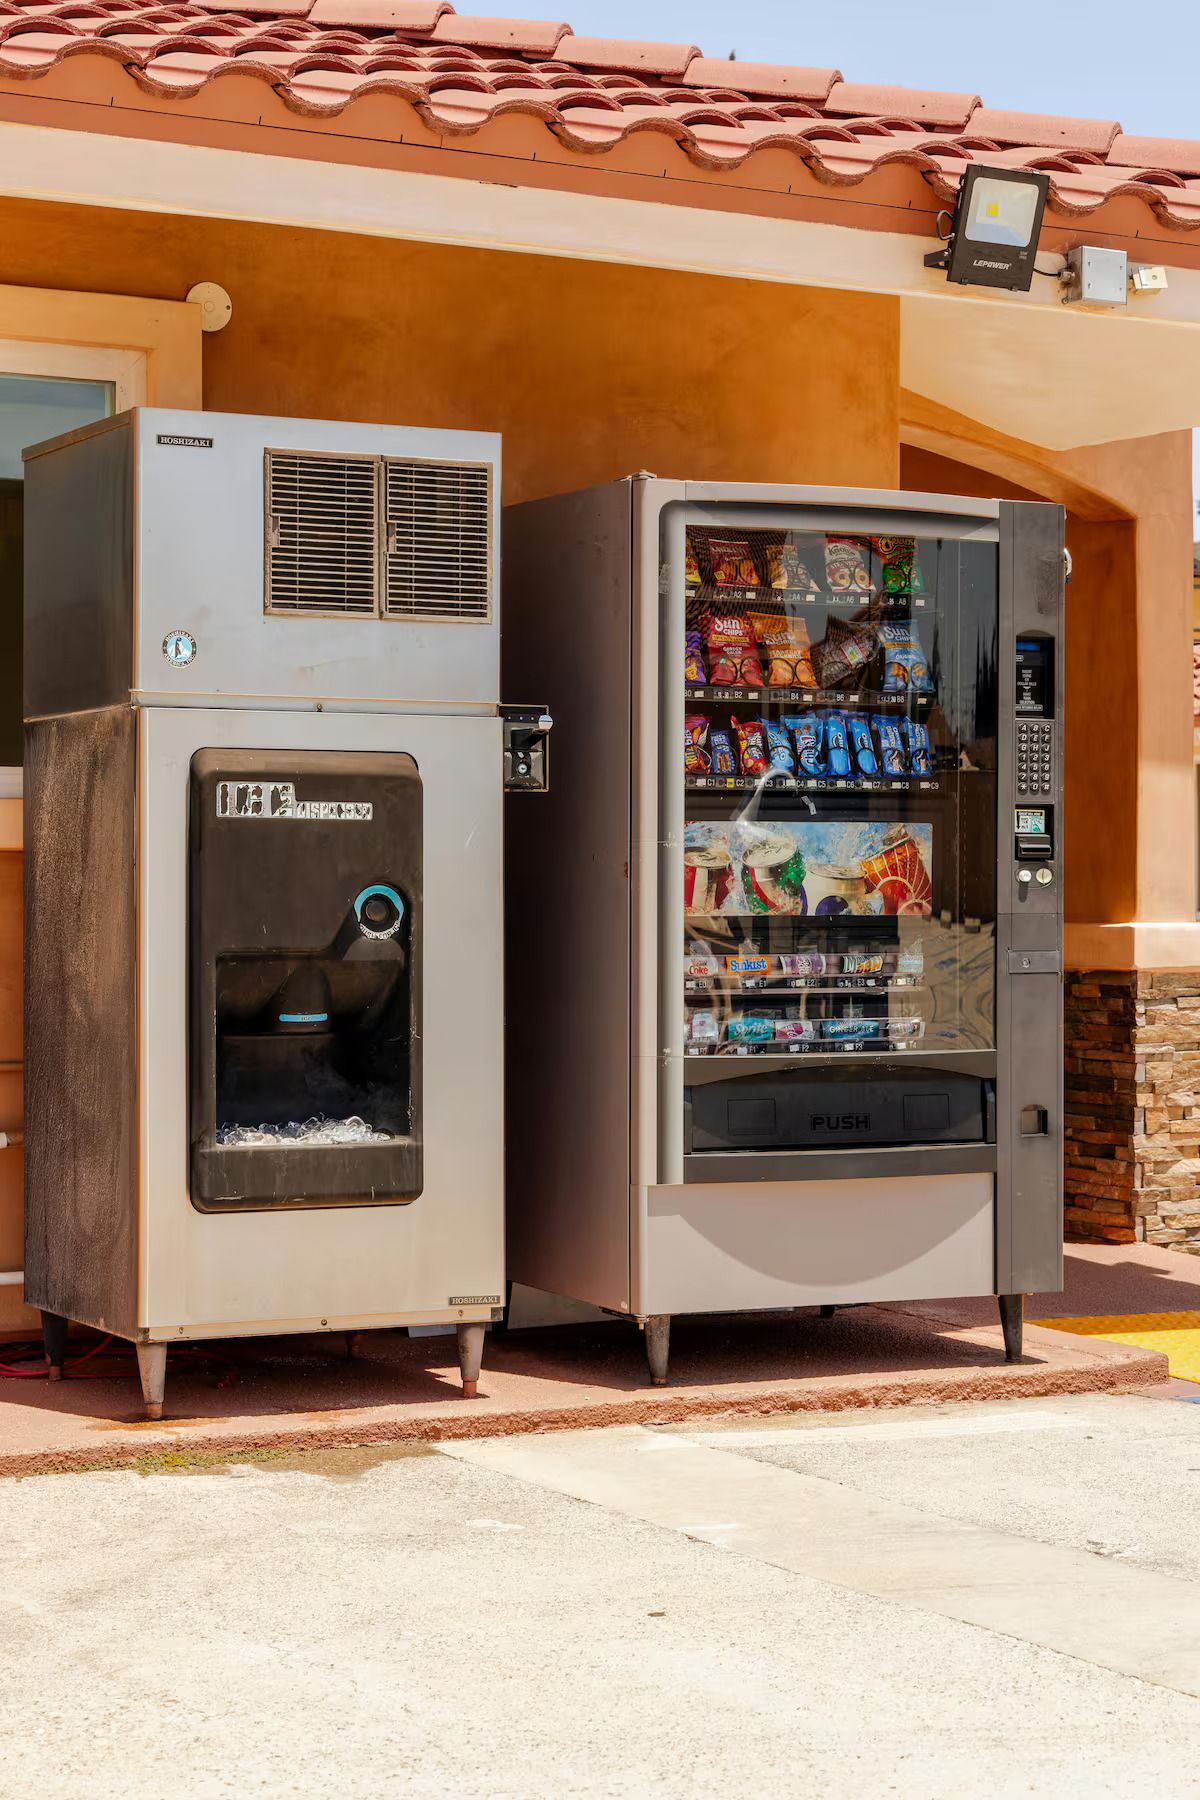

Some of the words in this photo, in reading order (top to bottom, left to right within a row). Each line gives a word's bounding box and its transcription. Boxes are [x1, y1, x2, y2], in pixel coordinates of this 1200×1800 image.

[973, 259, 1010, 270] LEPOWER
[160, 436, 210, 447] HOSHIZAKI
[714, 617, 740, 631] Sun
[883, 625, 911, 639] Sun
[896, 695, 905, 703] B8
[818, 780, 826, 788] C5
[901, 781, 910, 789] C8
[930, 782, 939, 790] C9
[729, 958, 768, 971] Sunkist
[688, 965, 710, 976] Coke
[734, 1023, 769, 1036] Sprite
[811, 1113, 870, 1131] PUSH
[451, 1296, 498, 1304] HOSHIZAKI
